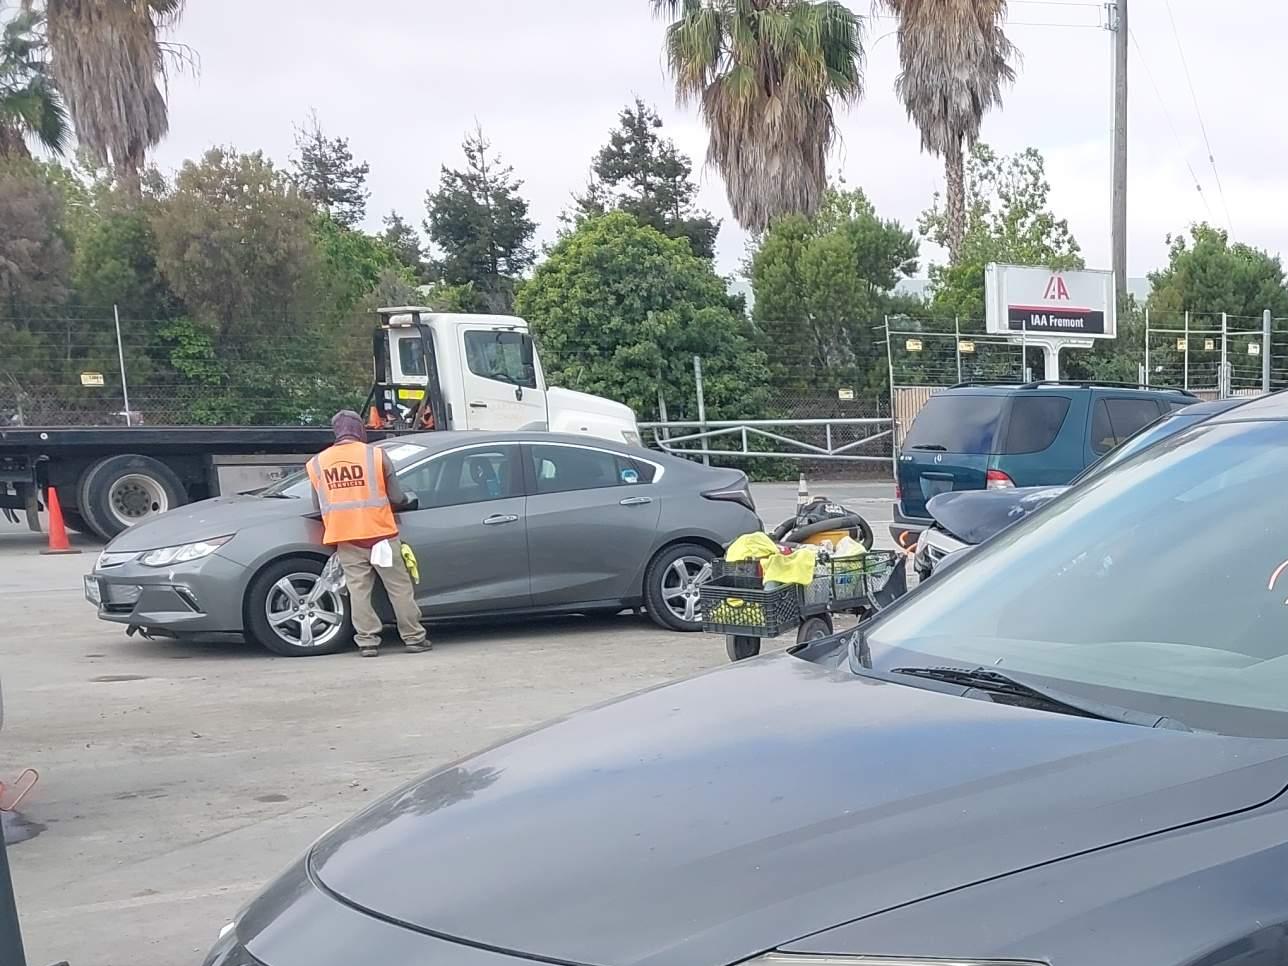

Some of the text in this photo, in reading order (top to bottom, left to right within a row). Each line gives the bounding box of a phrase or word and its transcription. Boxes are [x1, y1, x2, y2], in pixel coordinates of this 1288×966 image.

[1031, 314, 1084, 328] IAA Fremont
[323, 465, 364, 483] MAD
